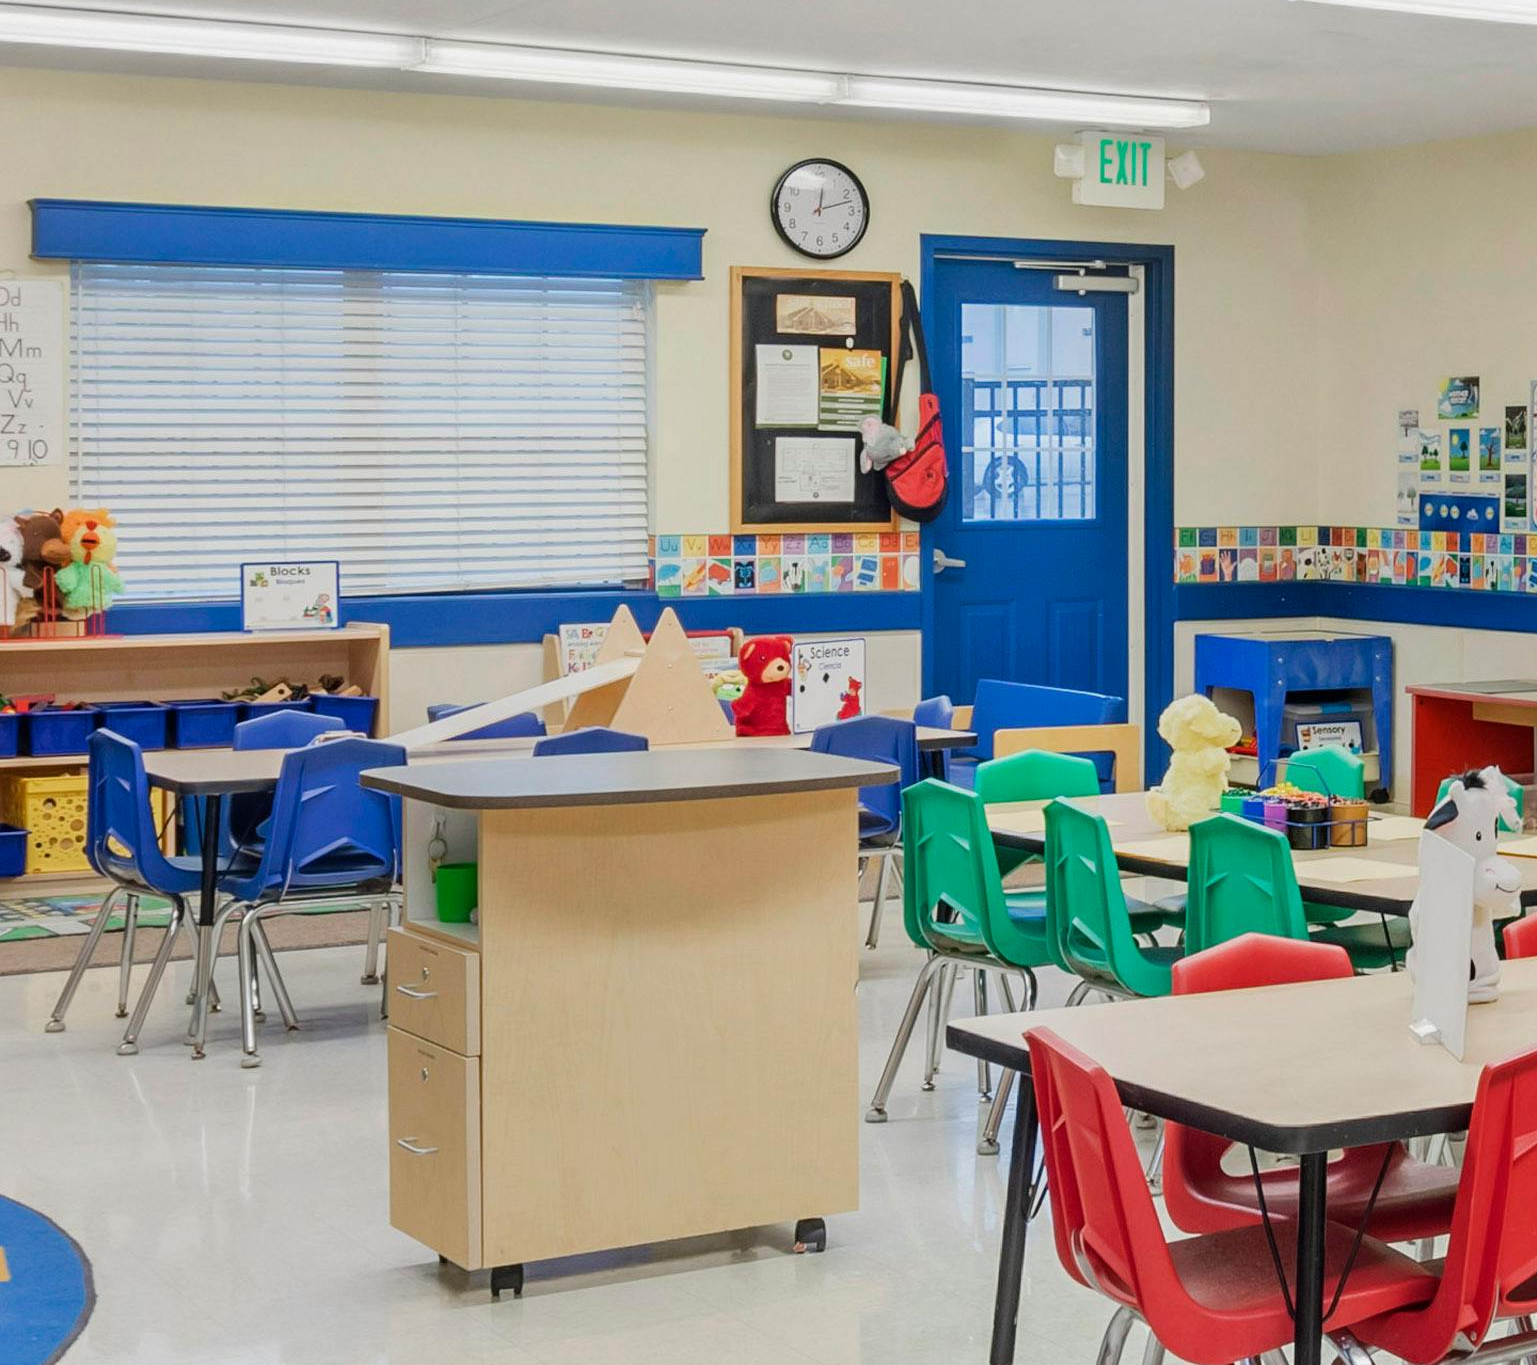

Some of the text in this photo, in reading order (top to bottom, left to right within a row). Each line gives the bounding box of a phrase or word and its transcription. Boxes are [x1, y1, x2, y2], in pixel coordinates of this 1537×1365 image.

[1100, 139, 1152, 186] EXIT
[843, 189, 850, 199] 2
[784, 202, 791, 212] 9
[848, 206, 855, 216] 3
[789, 218, 795, 228] 8
[843, 222, 849, 230] 4
[802, 231, 808, 241] 7
[816, 236, 823, 246] 6
[832, 233, 838, 243] 5
[0, 338, 42, 358] Mm
[845, 355, 876, 368] safe
[9, 389, 33, 409] Vv
[1, 415, 26, 434] Zz
[8, 440, 19, 460] 9
[28, 440, 48, 460] 10
[661, 539, 678, 553] Uu
[270, 567, 311, 576] Blocks
[810, 646, 849, 659] Science
[1313, 726, 1345, 734] Sensory
